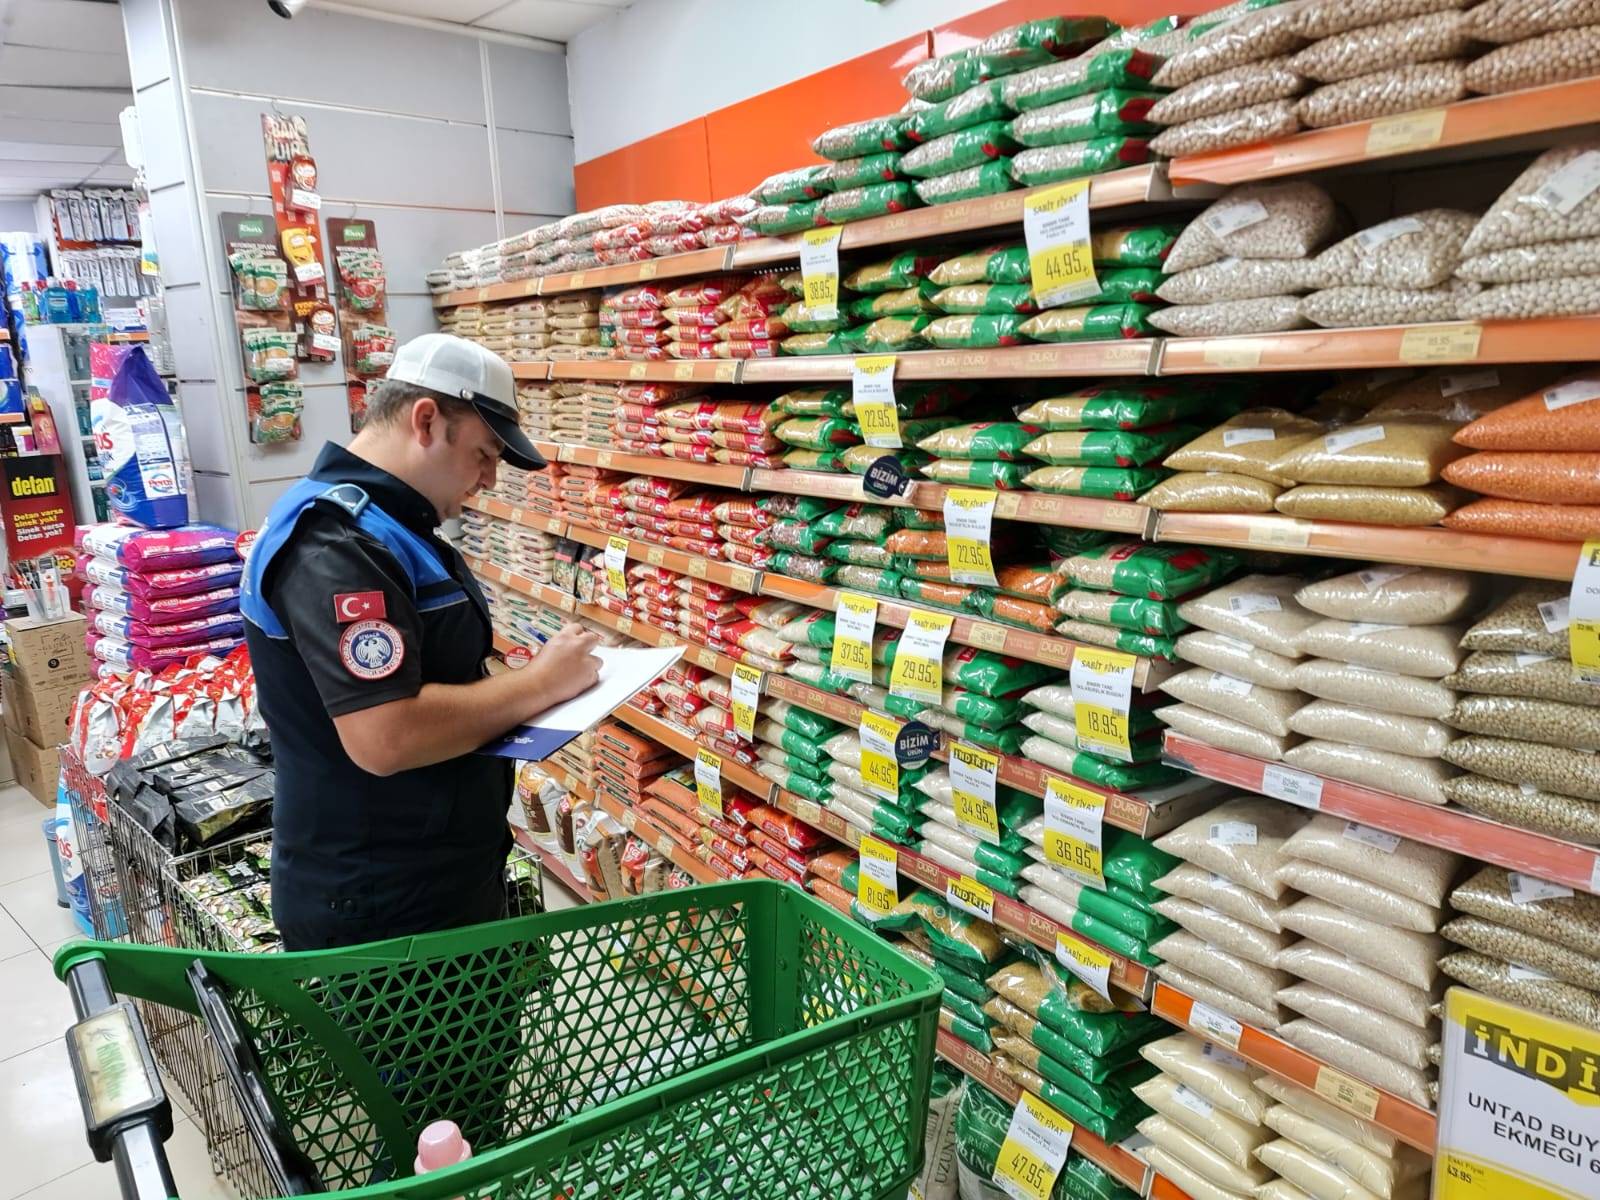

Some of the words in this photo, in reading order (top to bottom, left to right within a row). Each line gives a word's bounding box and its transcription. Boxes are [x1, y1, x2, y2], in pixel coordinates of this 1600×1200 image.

[11, 475, 55, 497] detan
[870, 466, 899, 486] BİZİM
[13, 512, 40, 521] Detan
[40, 508, 64, 517] varsa
[17, 532, 44, 542] Detan
[42, 523, 65, 531] varsa
[1081, 658, 1102, 671] SABİT
[1104, 664, 1126, 675] FİYAT
[900, 733, 929, 751] BİZİM
[1055, 791, 1075, 804] SABİT
[1076, 799, 1097, 812] FİYAT
[1112, 797, 1144, 817] DURU
[1030, 917, 1056, 935] DURU
[1025, 1104, 1044, 1121] SABİT
[1045, 1118, 1064, 1137] FİYAT
[1468, 1092, 1543, 1132] UNTAD
[1493, 1120, 1583, 1168] EKMEGI
[934, 1142, 957, 1184] UZUN
